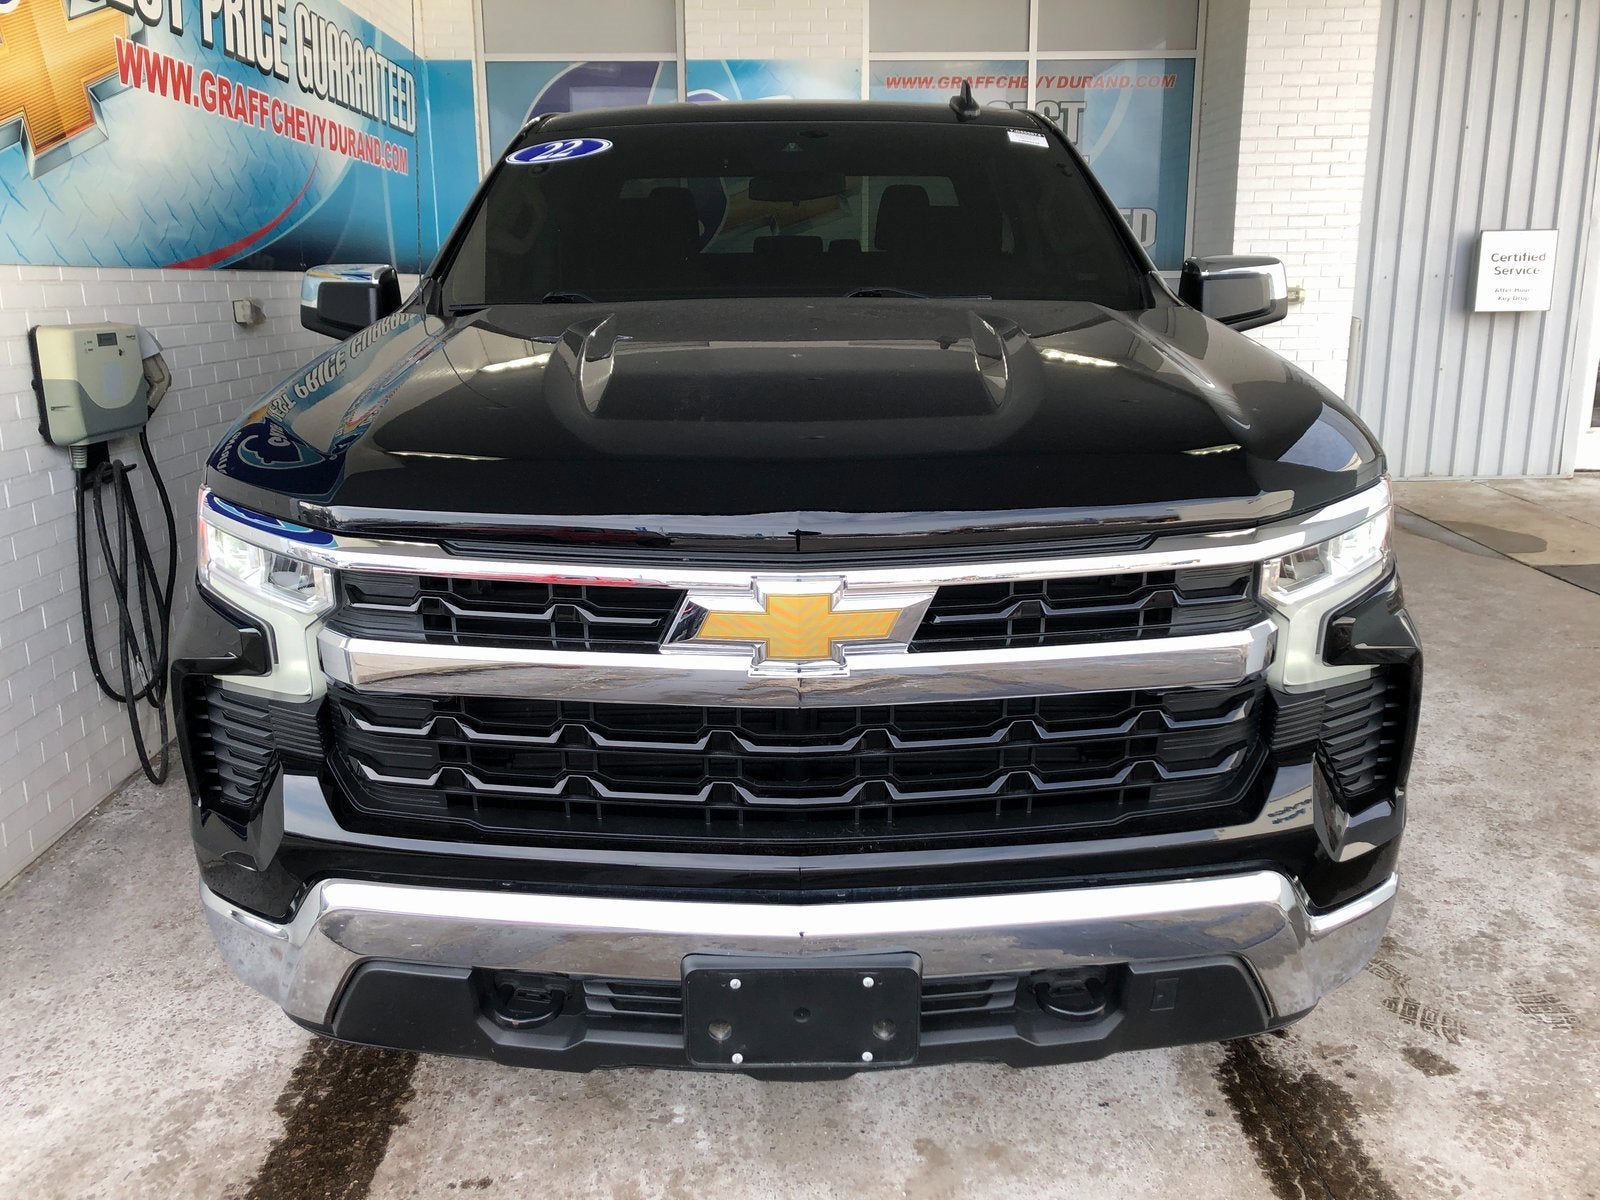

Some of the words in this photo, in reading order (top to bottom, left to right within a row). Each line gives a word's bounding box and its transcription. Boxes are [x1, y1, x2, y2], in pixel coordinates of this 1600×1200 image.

[293, 2, 416, 137] GUARANTEED
[114, 35, 408, 175] WWW.GRAFFCHEVYDURAND.COM
[528, 139, 583, 161] 22
[1491, 252, 1546, 262] Certified
[1494, 266, 1540, 275] Service
